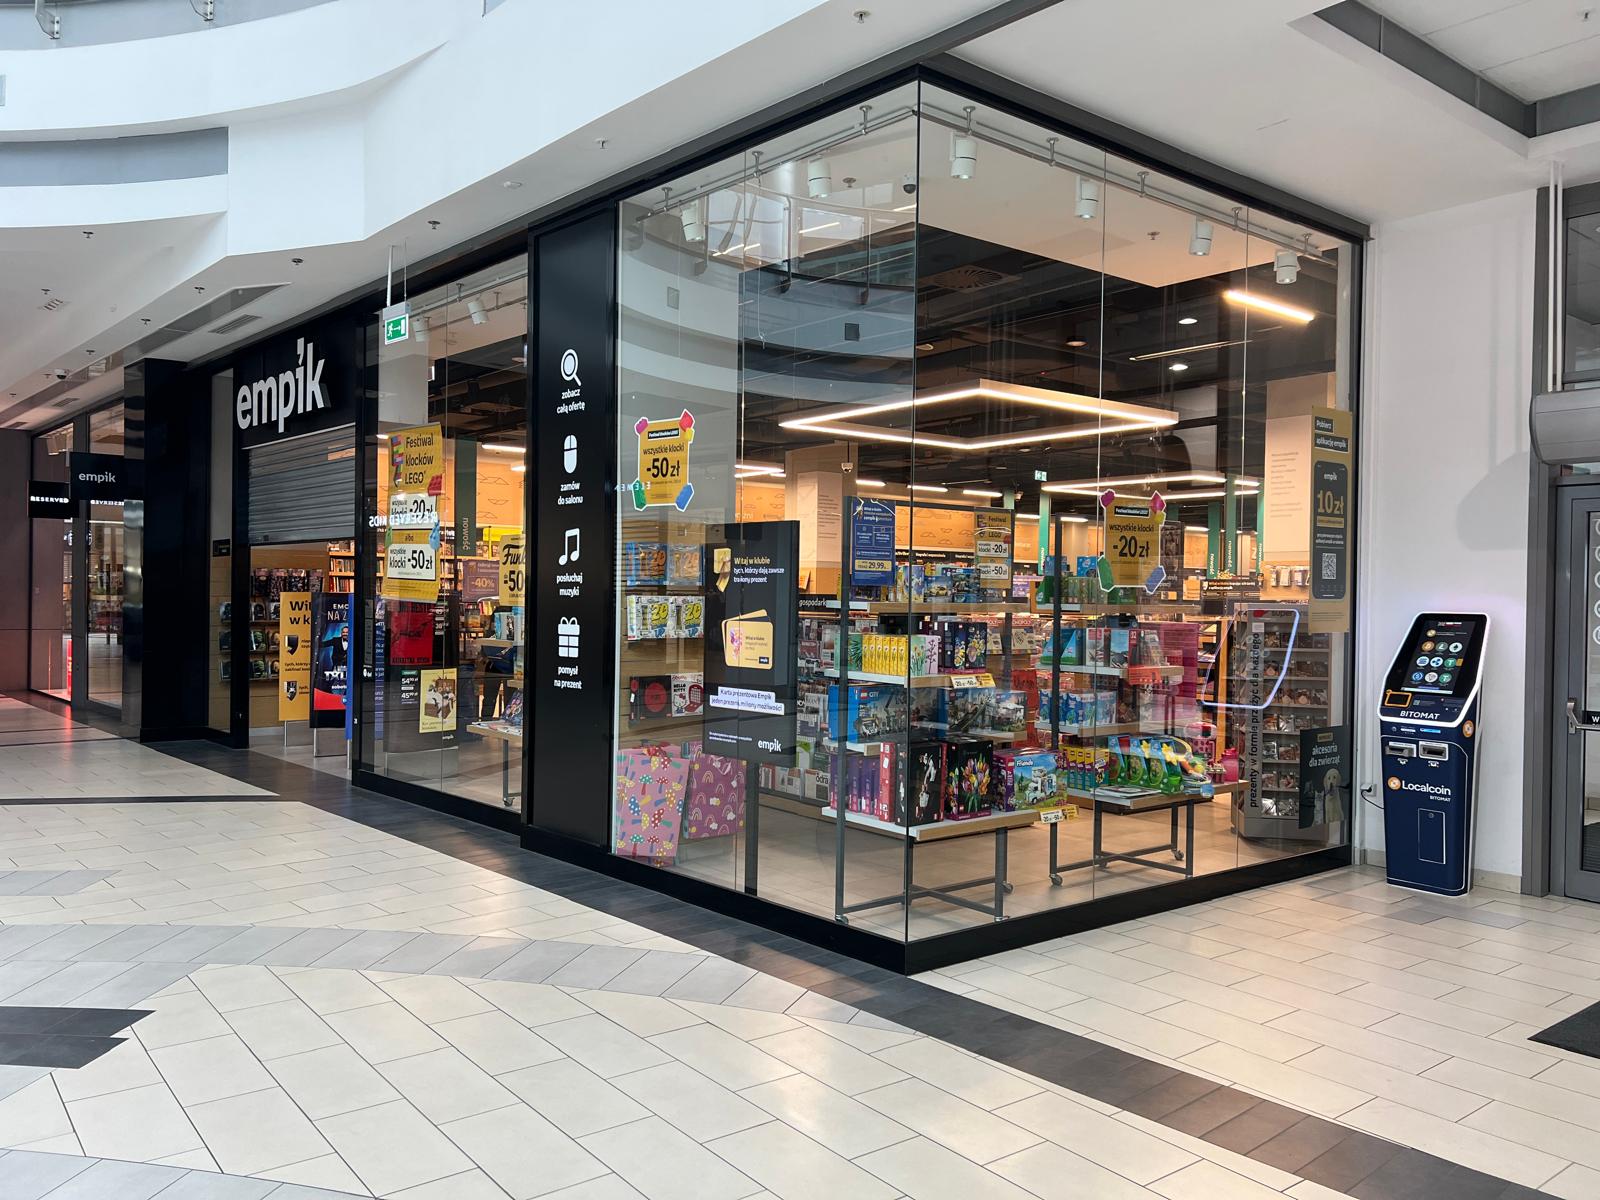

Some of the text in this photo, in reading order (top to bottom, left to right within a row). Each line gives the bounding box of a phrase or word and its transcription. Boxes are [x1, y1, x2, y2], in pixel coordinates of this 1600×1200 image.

[236, 336, 325, 433] empik
[561, 388, 581, 400] zobacz
[556, 401, 586, 414] całą ofertę
[405, 433, 434, 450] Festiwal
[642, 442, 685, 455] wszystkie klocki
[405, 453, 434, 467] klocków
[646, 457, 680, 478] -50 zł
[78, 471, 116, 483] empik
[1323, 471, 1338, 481] empik
[560, 481, 581, 492] zamów
[30, 496, 69, 504] RESERVED
[557, 494, 584, 505] do salonu
[463, 517, 471, 550] nowość
[1108, 523, 1155, 533] wszystkie klocki
[389, 548, 407, 556] wszystkie
[992, 544, 1003, 553] -20
[1112, 535, 1150, 558] -20 zł
[389, 549, 433, 570] klocki -50 zł
[734, 556, 749, 566] Witaj
[754, 556, 770, 565] klubie
[745, 567, 759, 575] którzy
[471, 578, 495, 588] -40%
[556, 572, 583, 584] posłuchaj
[559, 586, 580, 598] muzyki
[289, 617, 301, 625] w
[327, 610, 340, 621] NA
[557, 666, 579, 676] pomysł
[553, 679, 582, 690] na prezent
[1399, 710, 1440, 720] BITOMAT
[757, 738, 782, 753] empik
[1249, 725, 1258, 759] formie
[1312, 742, 1338, 756] akcesoria
[1308, 755, 1341, 768] dla zwierząt
[1250, 768, 1259, 808] prezenty
[1402, 780, 1451, 796] Localcoin
[1429, 795, 1451, 803] BITOMAT
